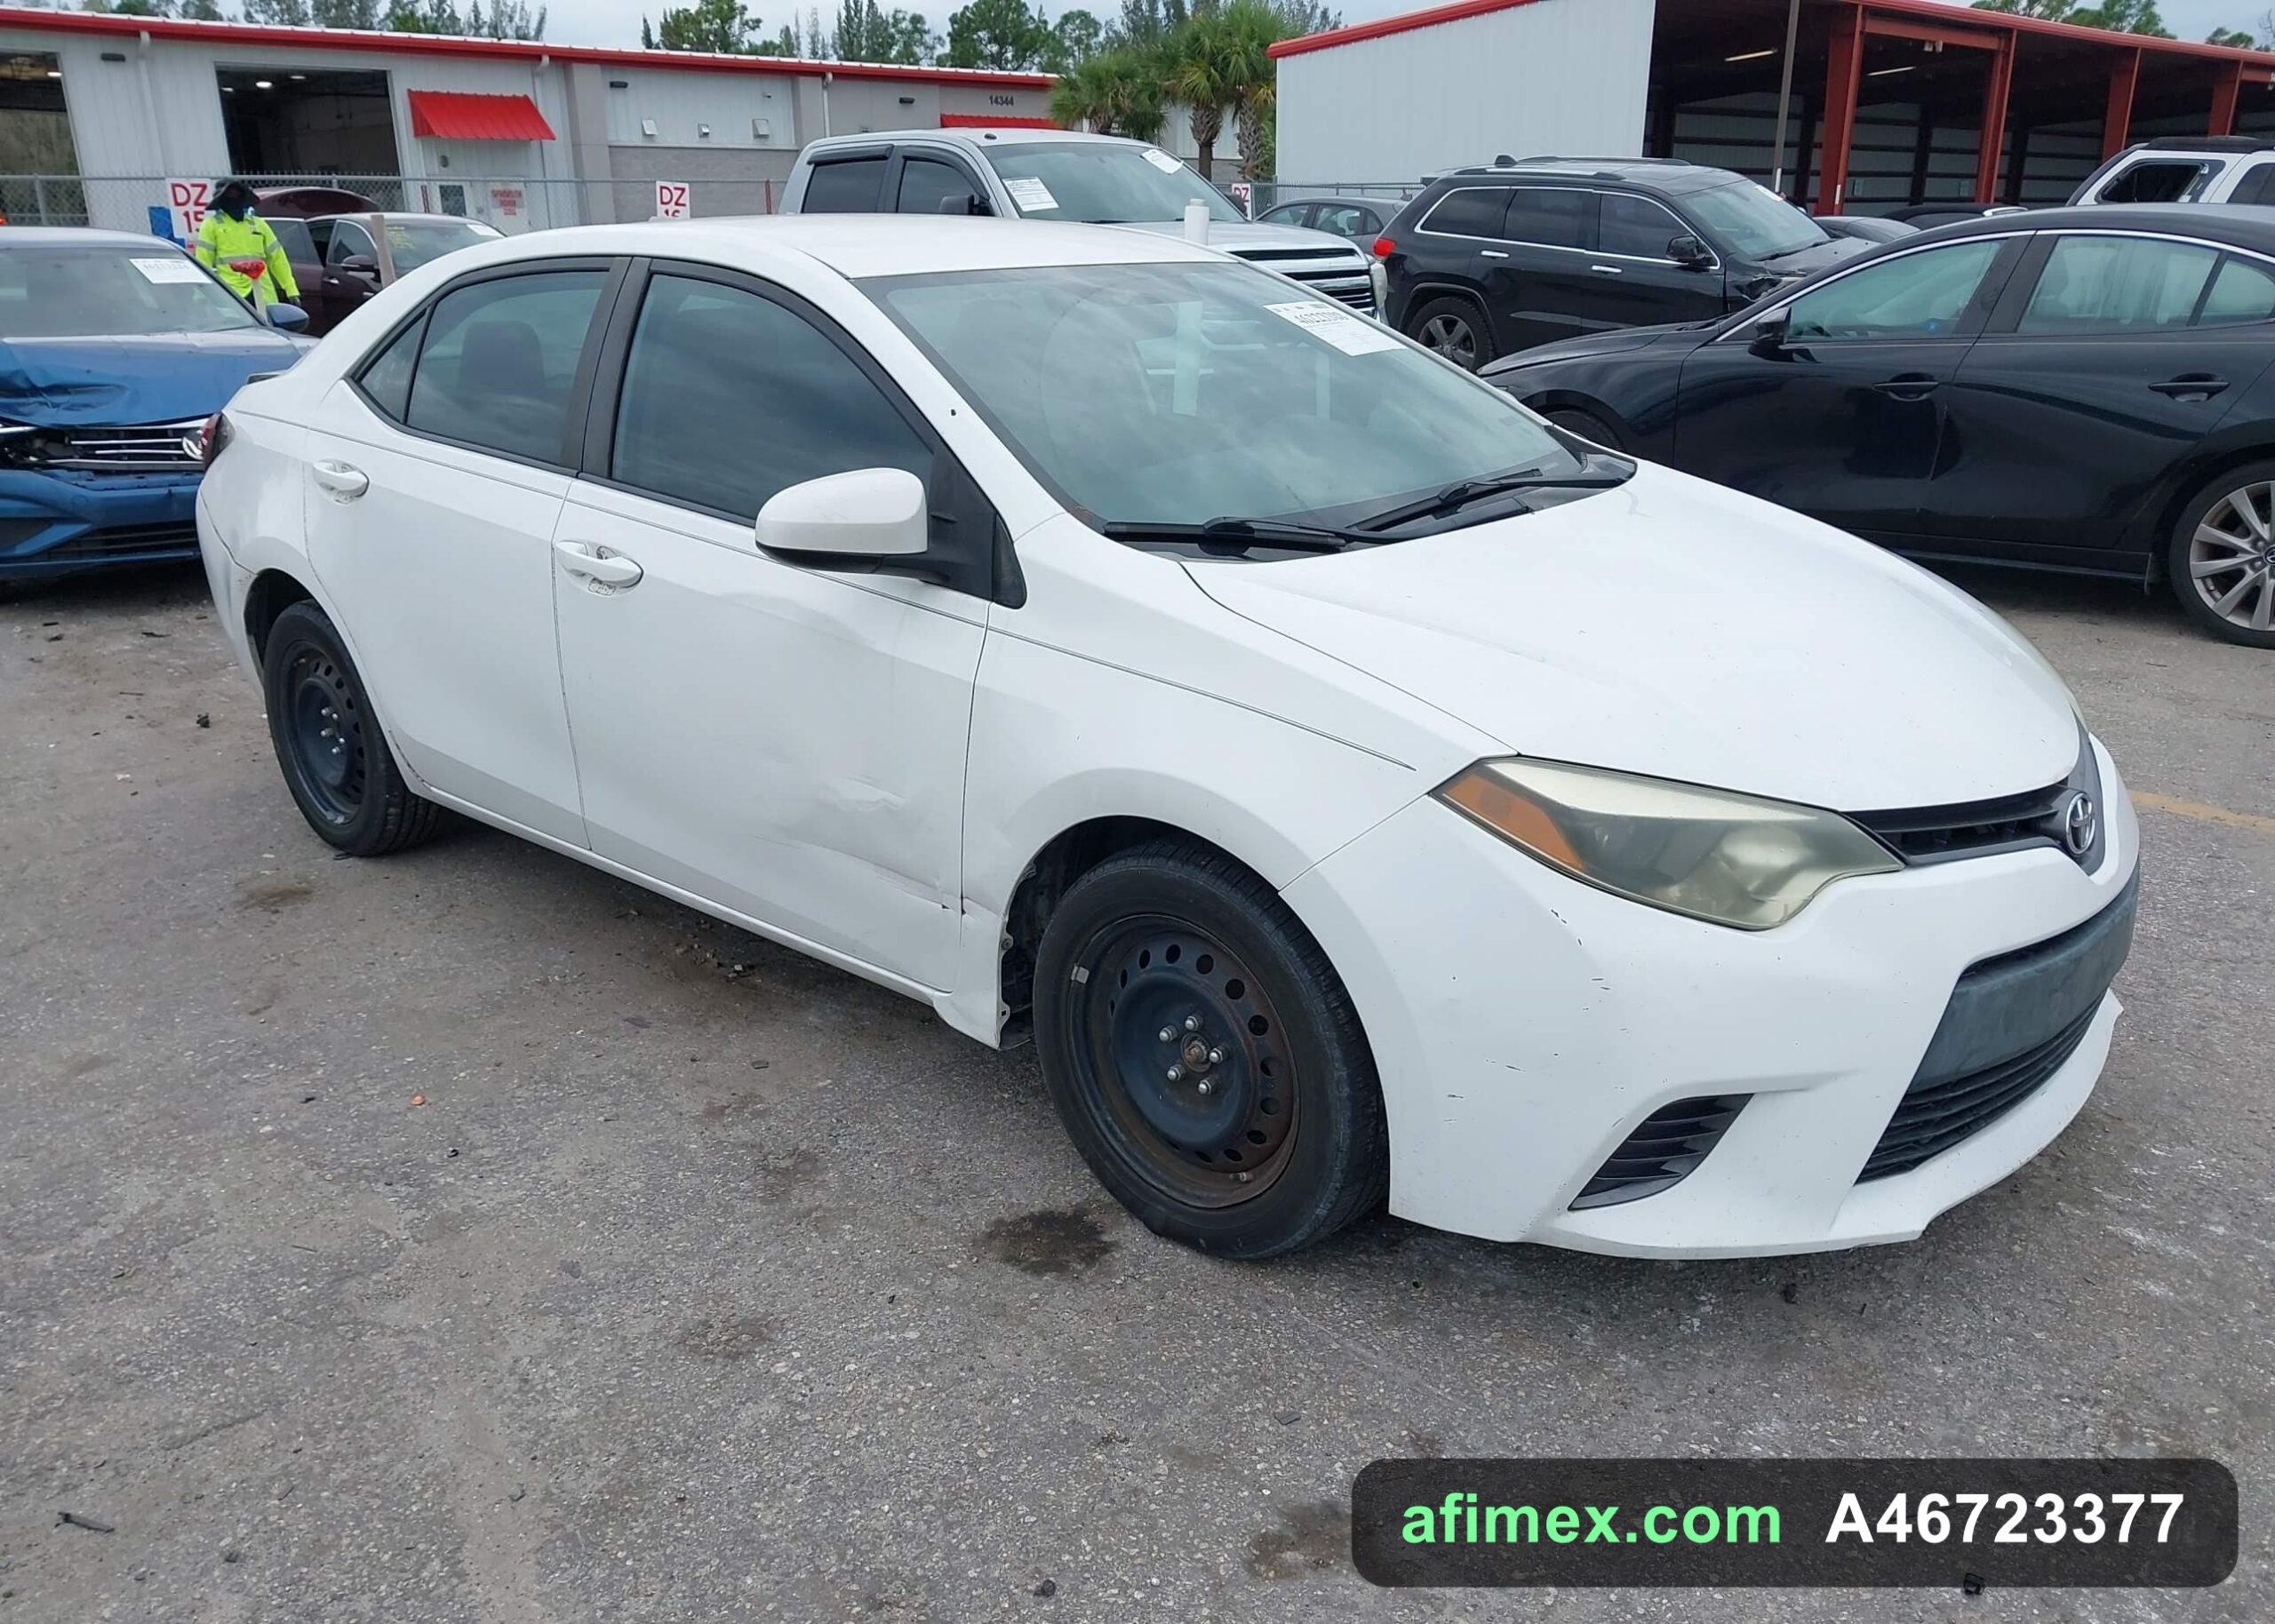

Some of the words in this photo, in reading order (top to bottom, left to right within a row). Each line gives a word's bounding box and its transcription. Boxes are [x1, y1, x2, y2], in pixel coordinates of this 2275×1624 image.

[988, 94, 1014, 107] 14344
[171, 183, 209, 206] DZ
[659, 186, 686, 206] DZ
